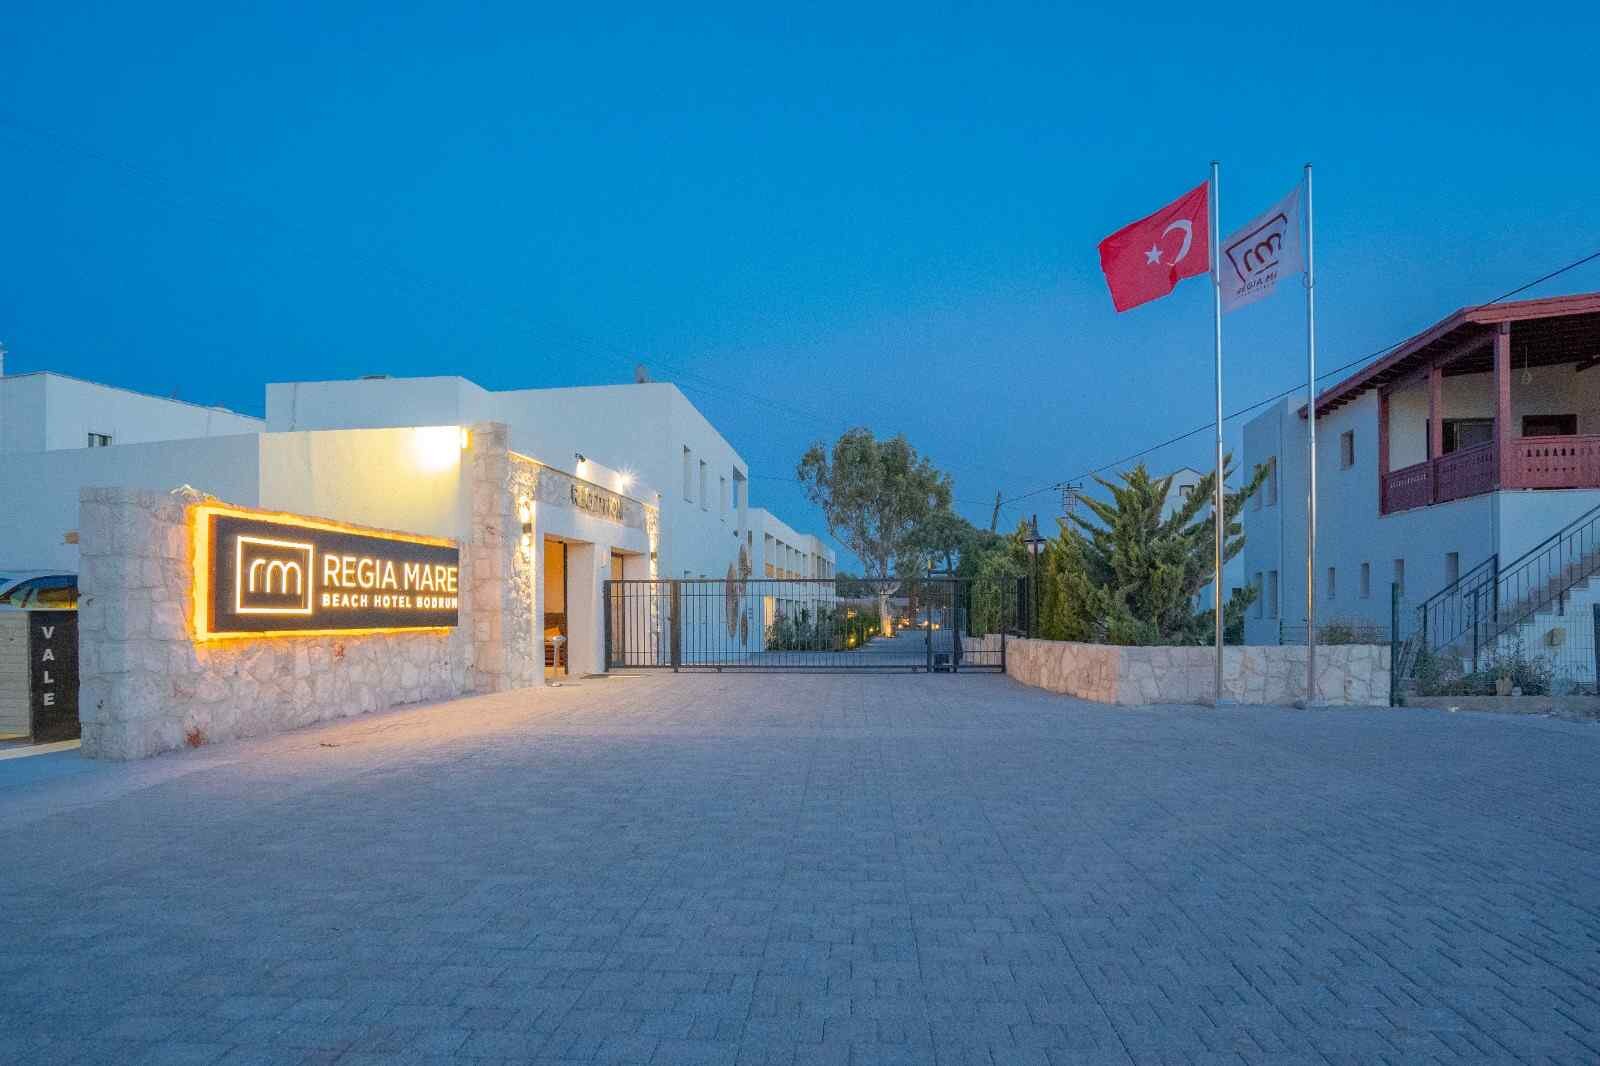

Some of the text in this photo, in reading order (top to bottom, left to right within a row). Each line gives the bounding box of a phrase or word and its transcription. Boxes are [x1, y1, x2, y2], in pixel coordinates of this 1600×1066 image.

[323, 554, 458, 593] REGIA MARE
[322, 593, 368, 608] BEACH
[374, 594, 412, 608] HOTEL
[41, 626, 55, 706] VALE
